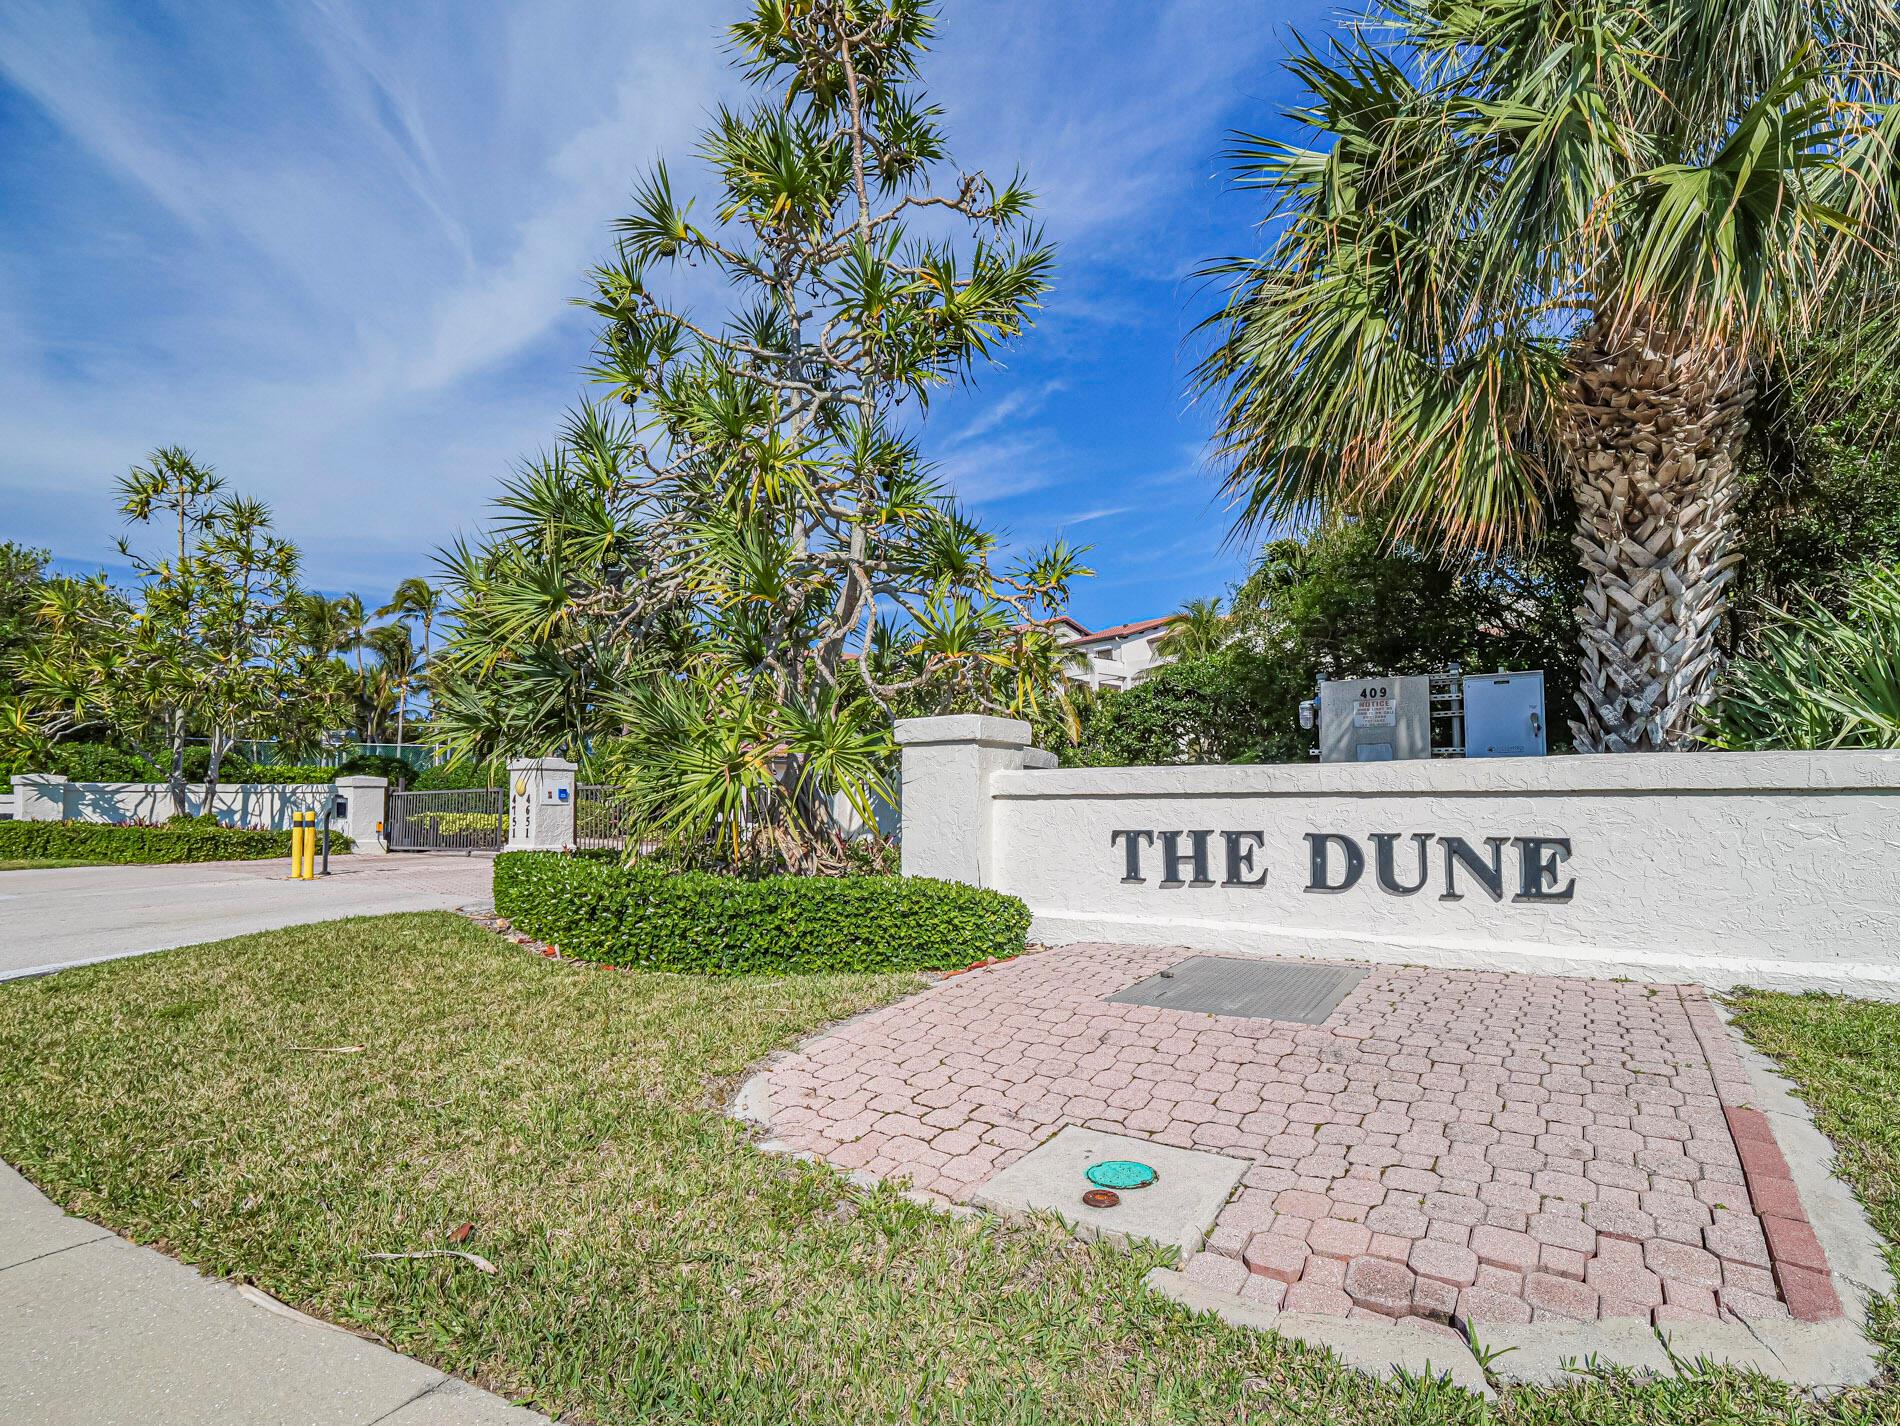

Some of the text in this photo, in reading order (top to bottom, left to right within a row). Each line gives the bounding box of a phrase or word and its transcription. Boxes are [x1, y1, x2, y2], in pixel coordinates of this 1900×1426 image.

[1360, 687, 1387, 698] 409
[1111, 829, 1577, 904] THE DUNE
